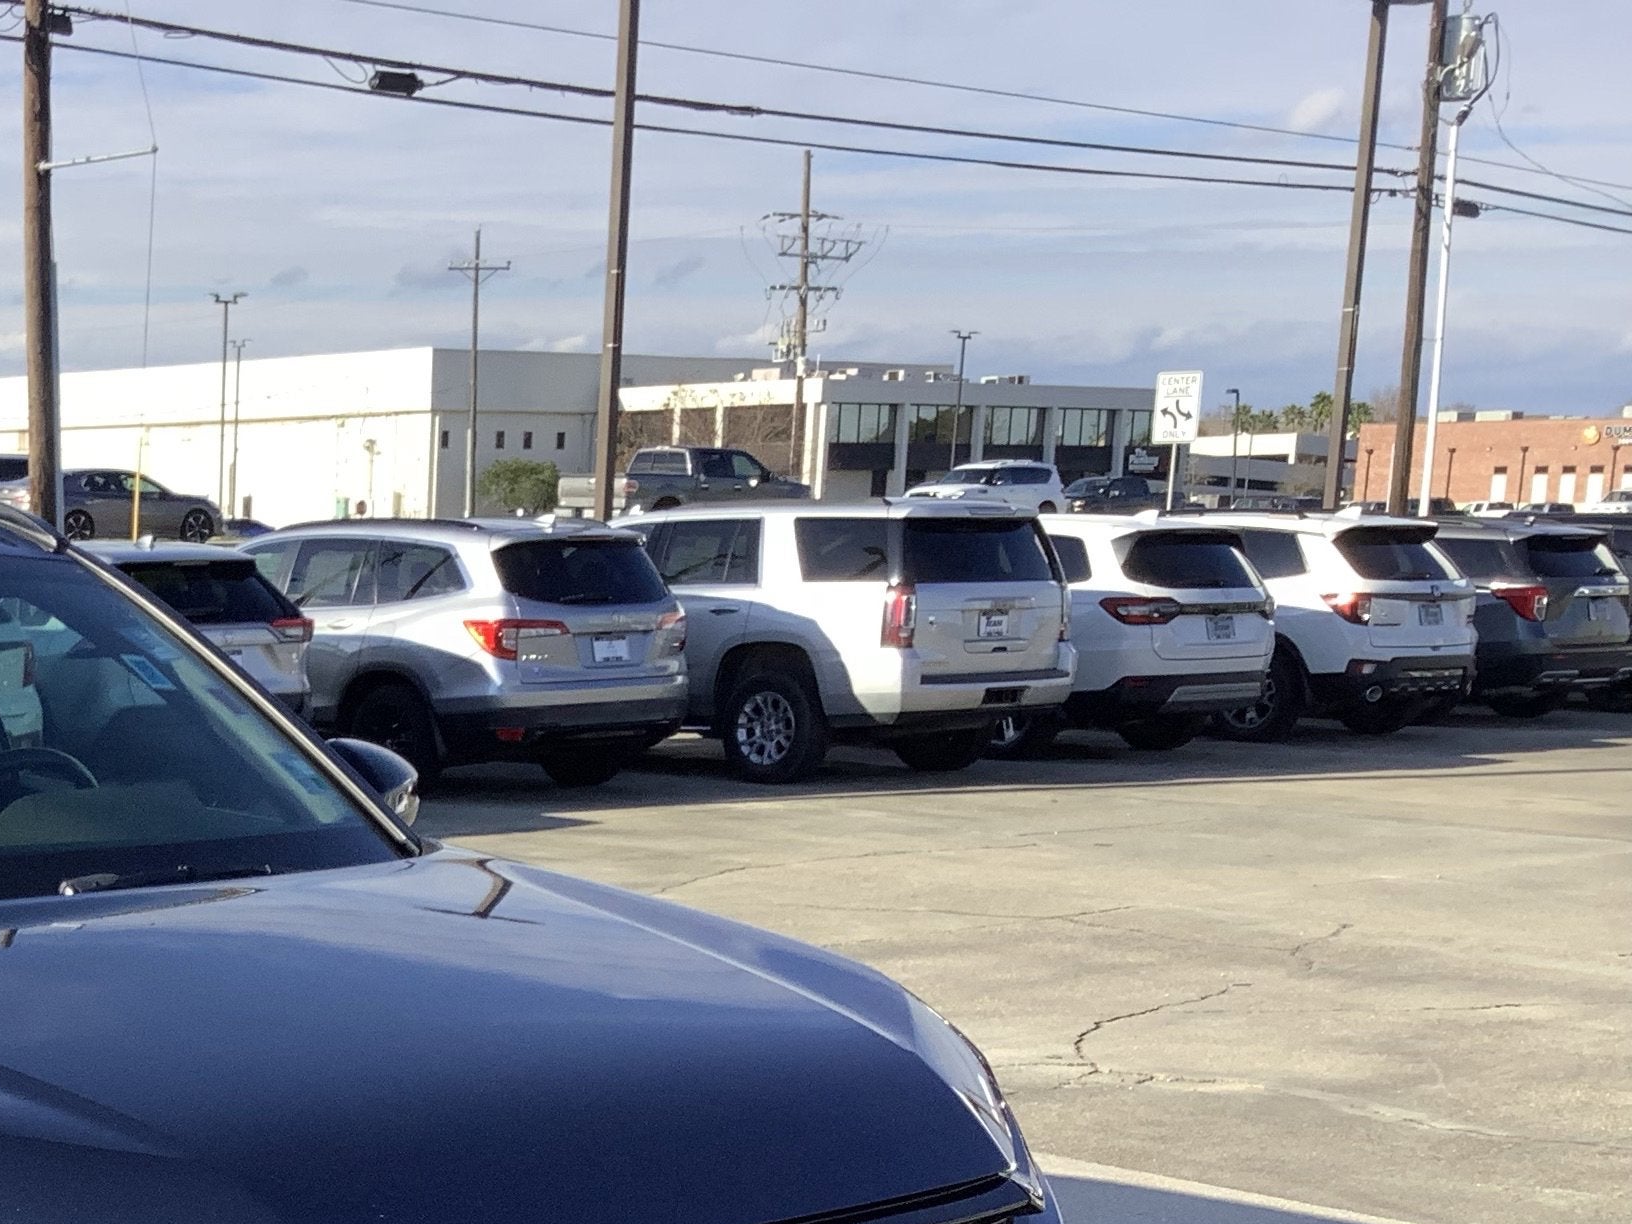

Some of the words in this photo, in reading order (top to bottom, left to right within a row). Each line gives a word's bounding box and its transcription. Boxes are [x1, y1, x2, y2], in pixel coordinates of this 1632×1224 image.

[1161, 375, 1198, 386] CENTER
[1167, 386, 1191, 396] LANE
[1162, 430, 1187, 439] ONLY
